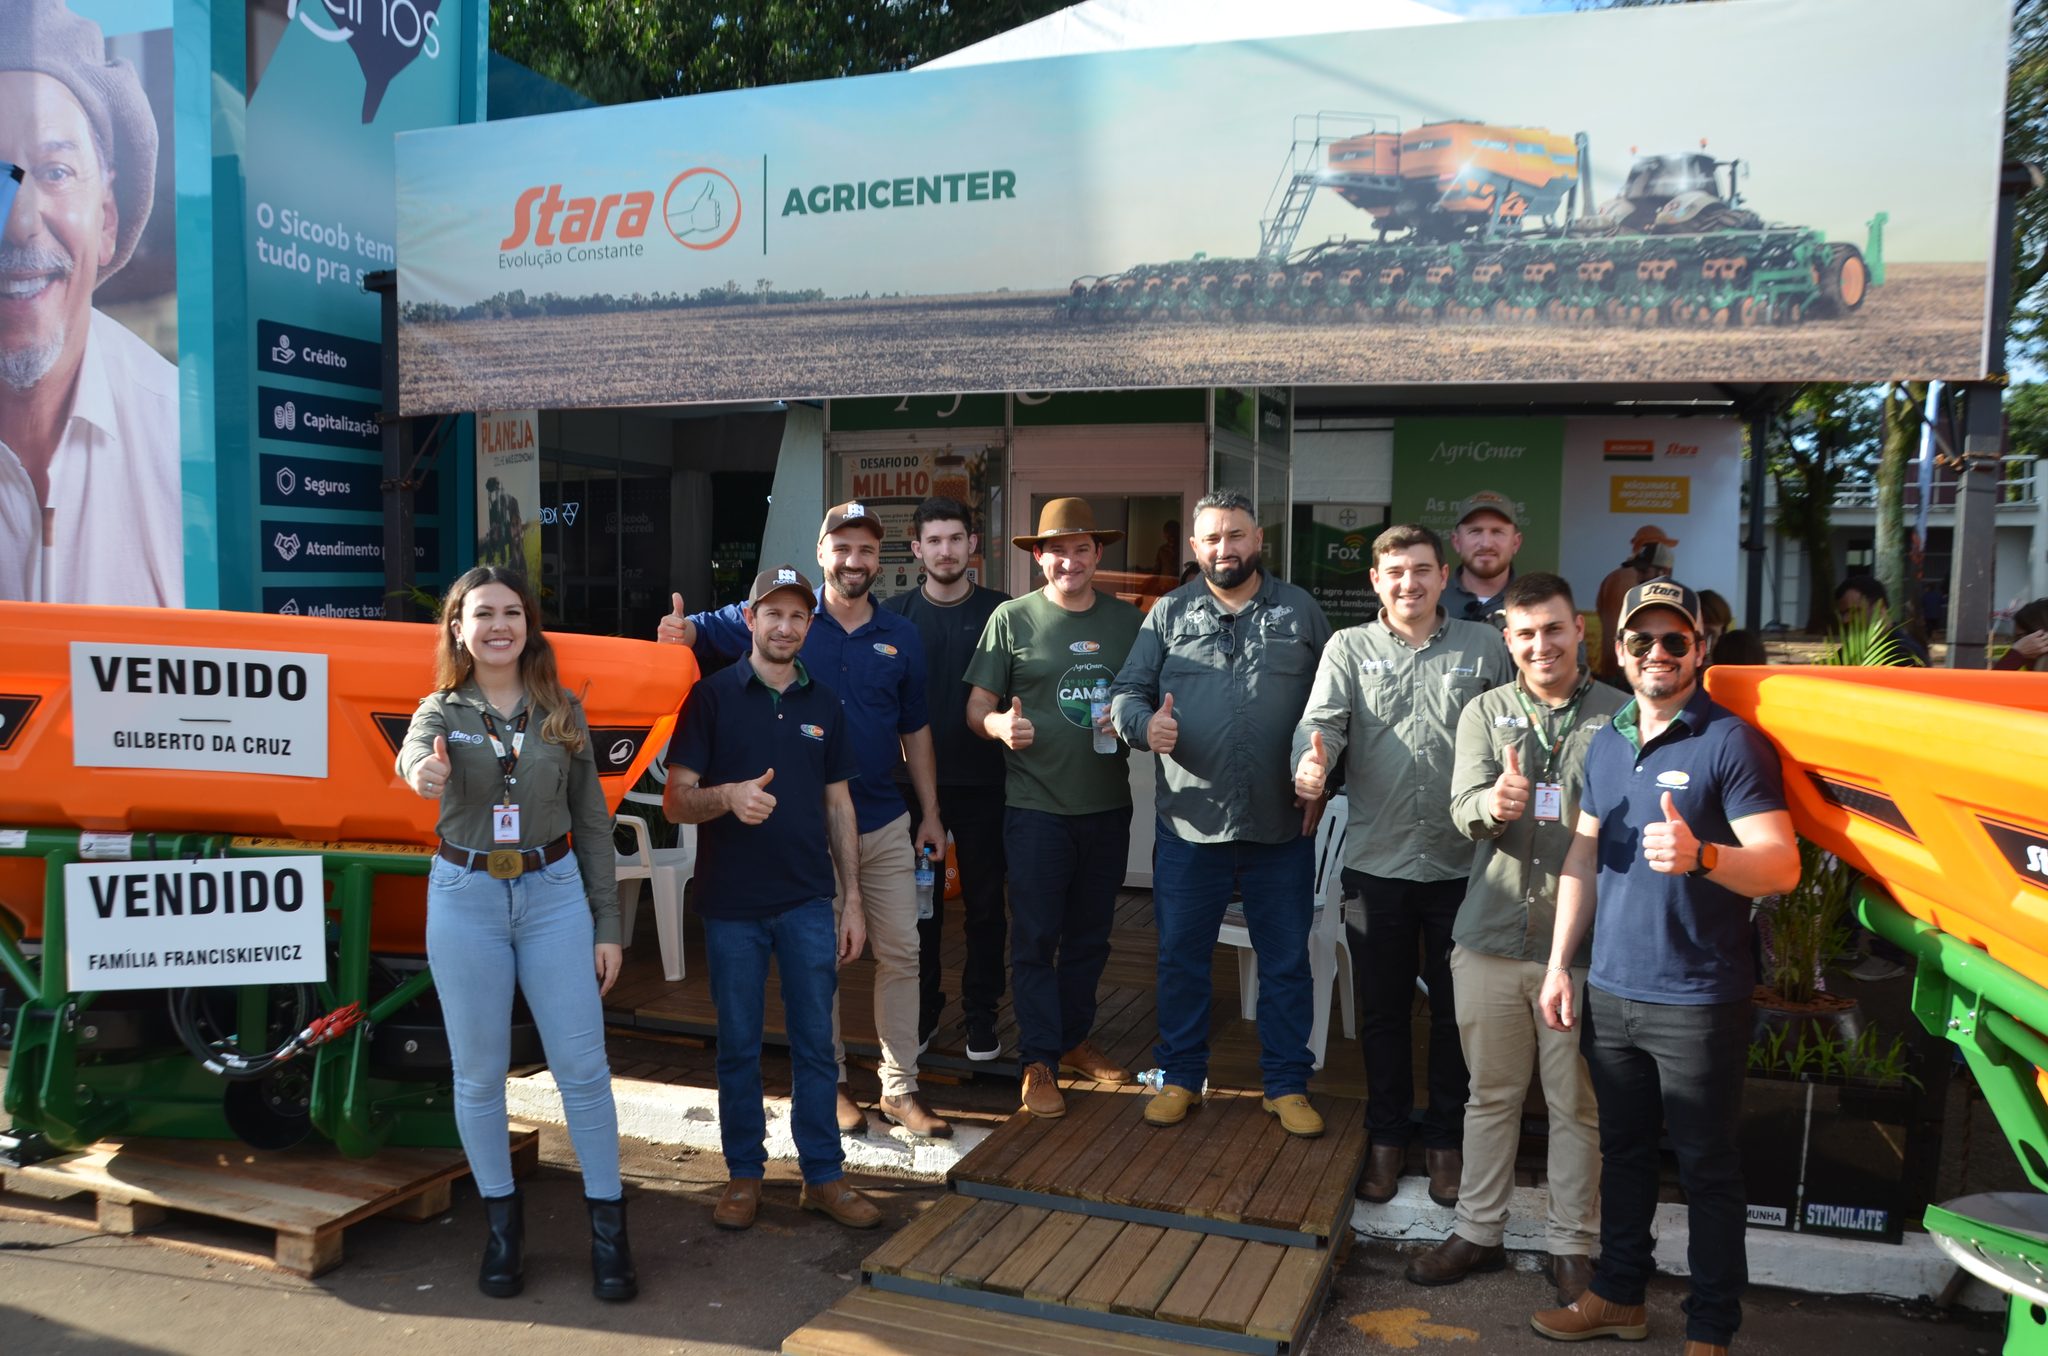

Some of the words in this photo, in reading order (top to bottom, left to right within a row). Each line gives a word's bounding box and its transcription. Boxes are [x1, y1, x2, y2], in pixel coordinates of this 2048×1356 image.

[781, 169, 1017, 217] AGRICENTER
[501, 183, 655, 251] Stara
[257, 202, 274, 229] O
[280, 208, 350, 251] Sicoob
[355, 232, 395, 264] tem
[256, 236, 311, 273] tudo
[316, 257, 350, 285] pra
[498, 248, 563, 270] Evolução
[567, 242, 644, 263] Constante
[302, 347, 348, 369] Crédito
[303, 411, 380, 437] Capitalização
[481, 419, 534, 456] PLANEJA
[860, 456, 903, 470] DESAFIO
[903, 455, 919, 467] DO
[1429, 440, 1527, 465] AgriCenter
[304, 476, 351, 496] Seguros
[853, 470, 930, 498] MILHO
[305, 541, 381, 558] Atendimento
[1327, 543, 1361, 561] Fox
[1643, 584, 1681, 598] Stara
[307, 603, 360, 618] Melhores
[90, 655, 308, 702] VENDIDO
[113, 730, 205, 752] GILBERTO
[212, 734, 236, 753] DA
[243, 736, 292, 757] CRUZ
[448, 729, 471, 742] Stara
[88, 867, 304, 919] VENDIDO
[88, 948, 158, 971] FAMÍLIA
[163, 944, 303, 968] FRANCISKIEVICZ
[1806, 1203, 1884, 1232] STIMULATE
